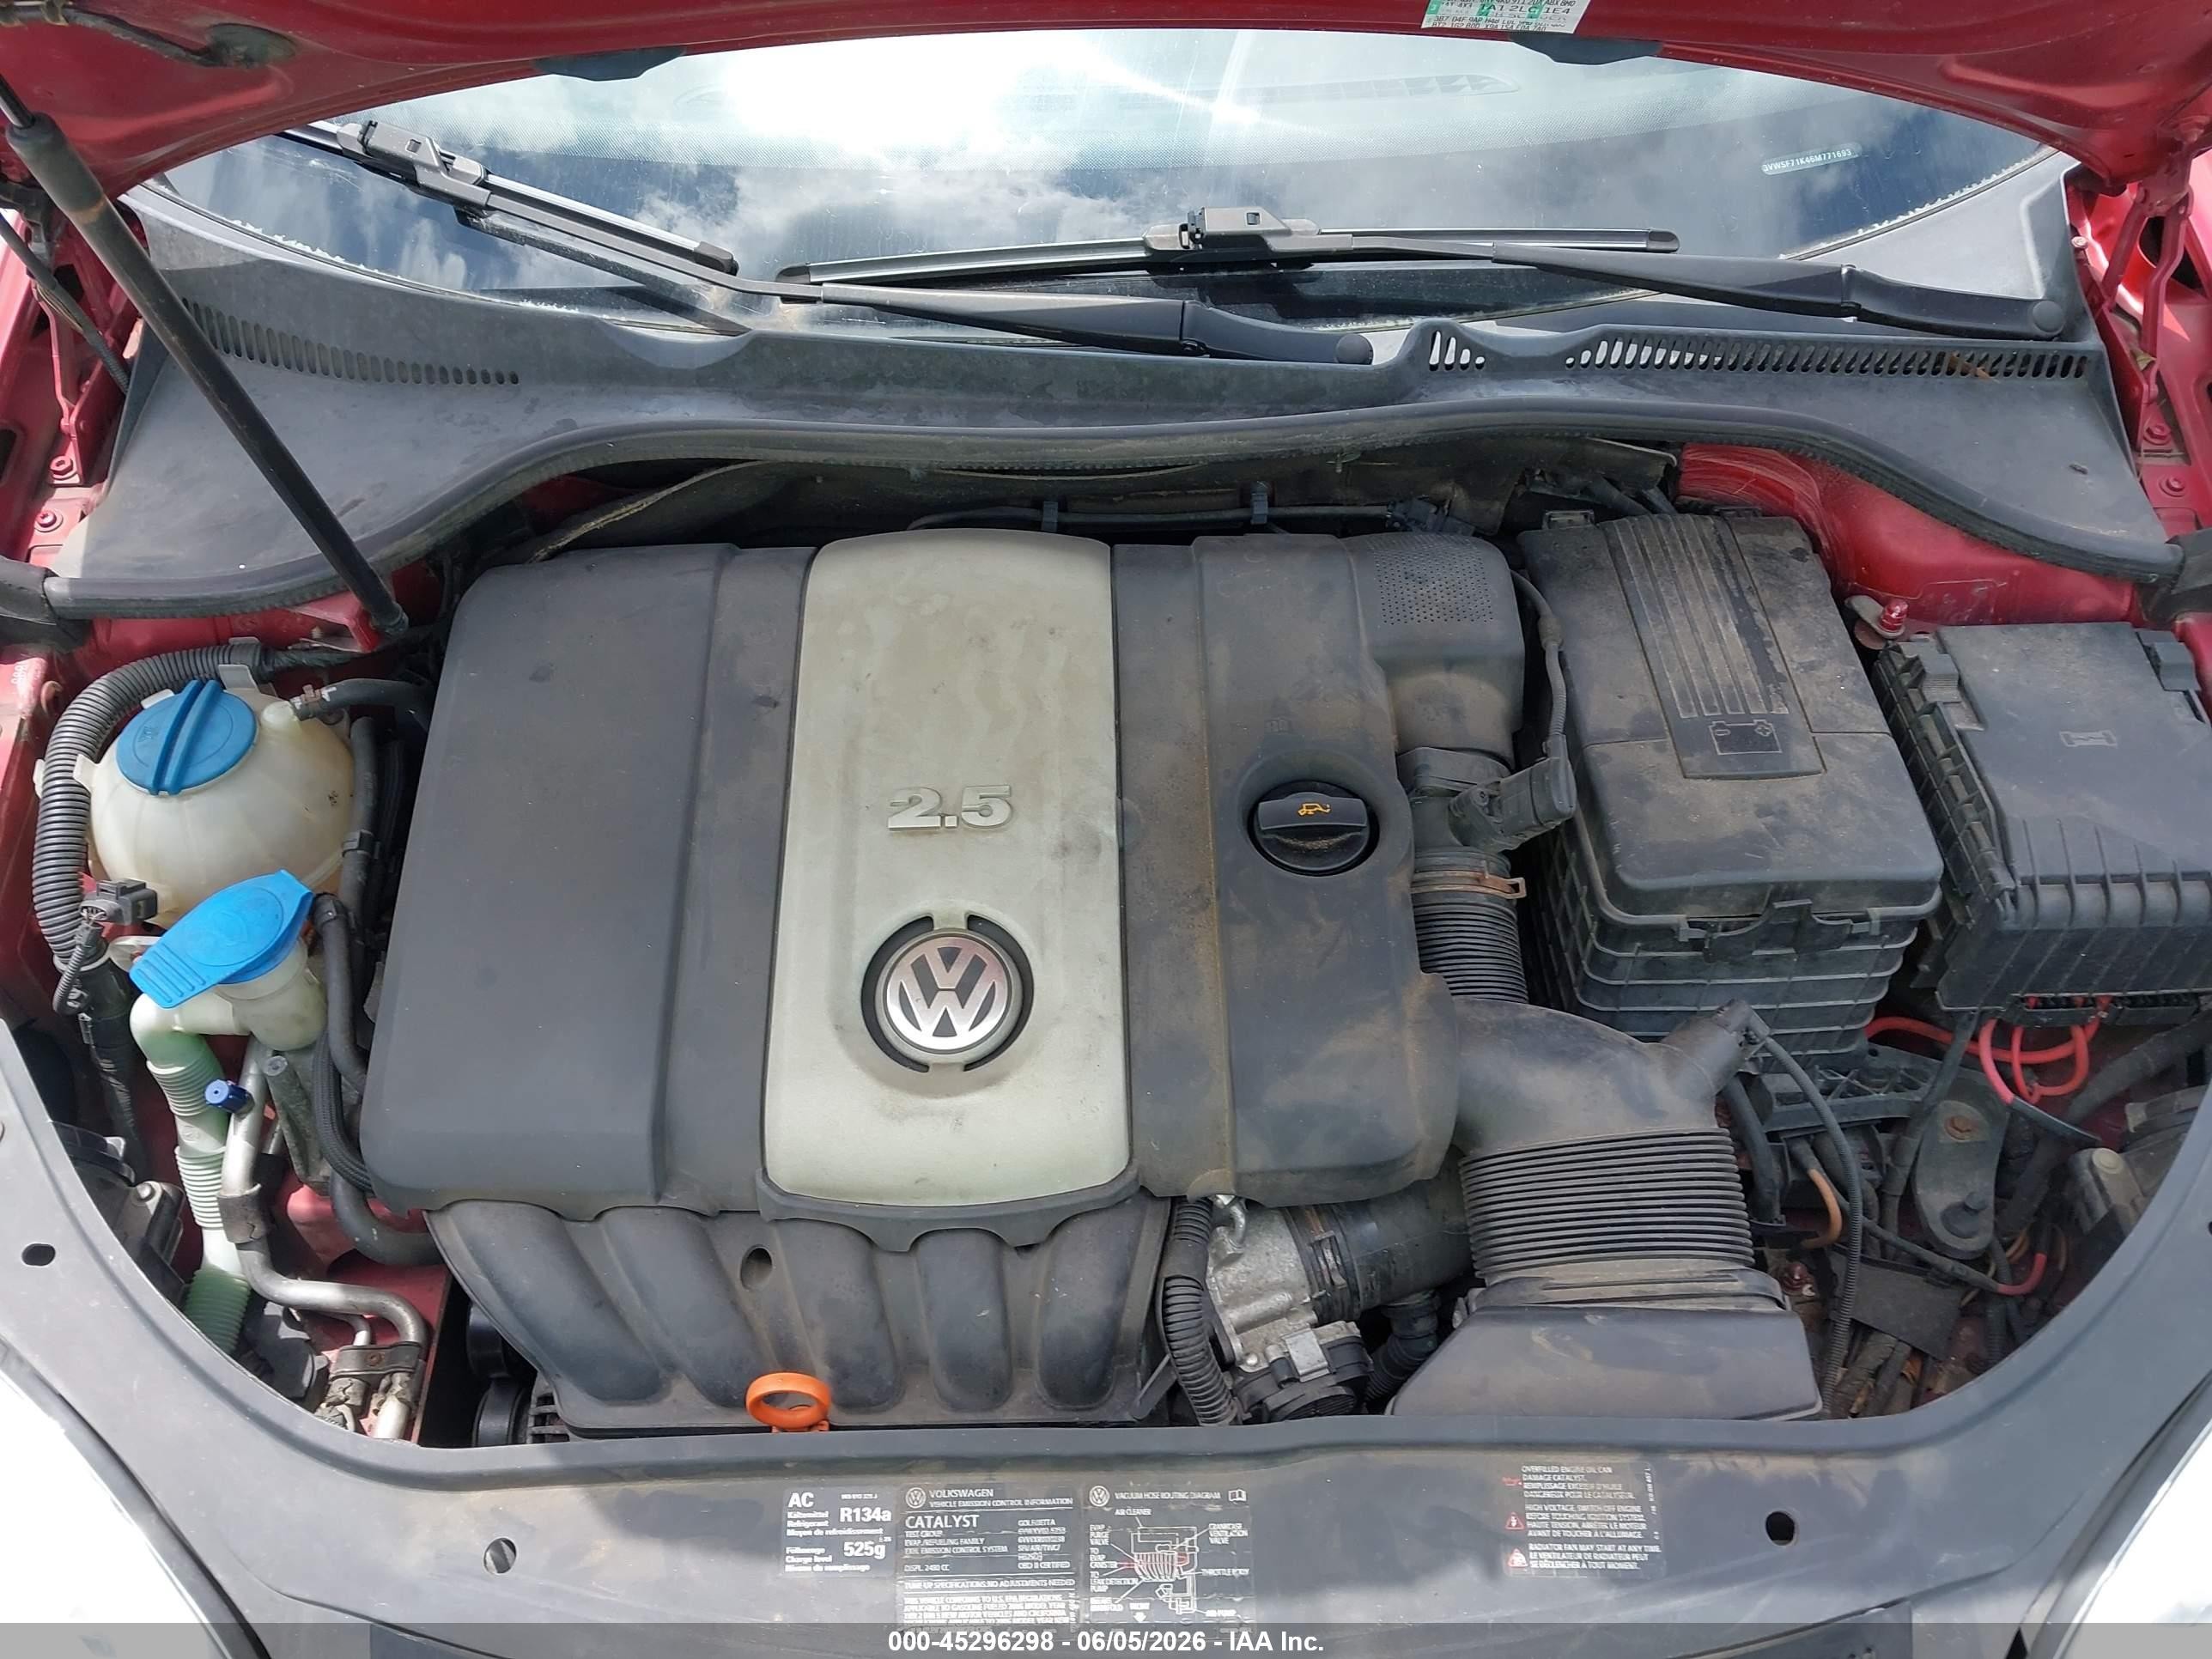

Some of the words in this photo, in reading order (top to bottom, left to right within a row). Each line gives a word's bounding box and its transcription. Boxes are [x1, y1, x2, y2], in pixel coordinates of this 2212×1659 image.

[887, 784, 1012, 831] 2.5
[886, 936, 1008, 1051] VW
[788, 1492, 815, 1508] AC
[928, 1488, 994, 1498] VOLKSWAGEN
[840, 1506, 893, 1522] R134a
[905, 1514, 980, 1528] CATALYST
[843, 1540, 886, 1560] 525g
